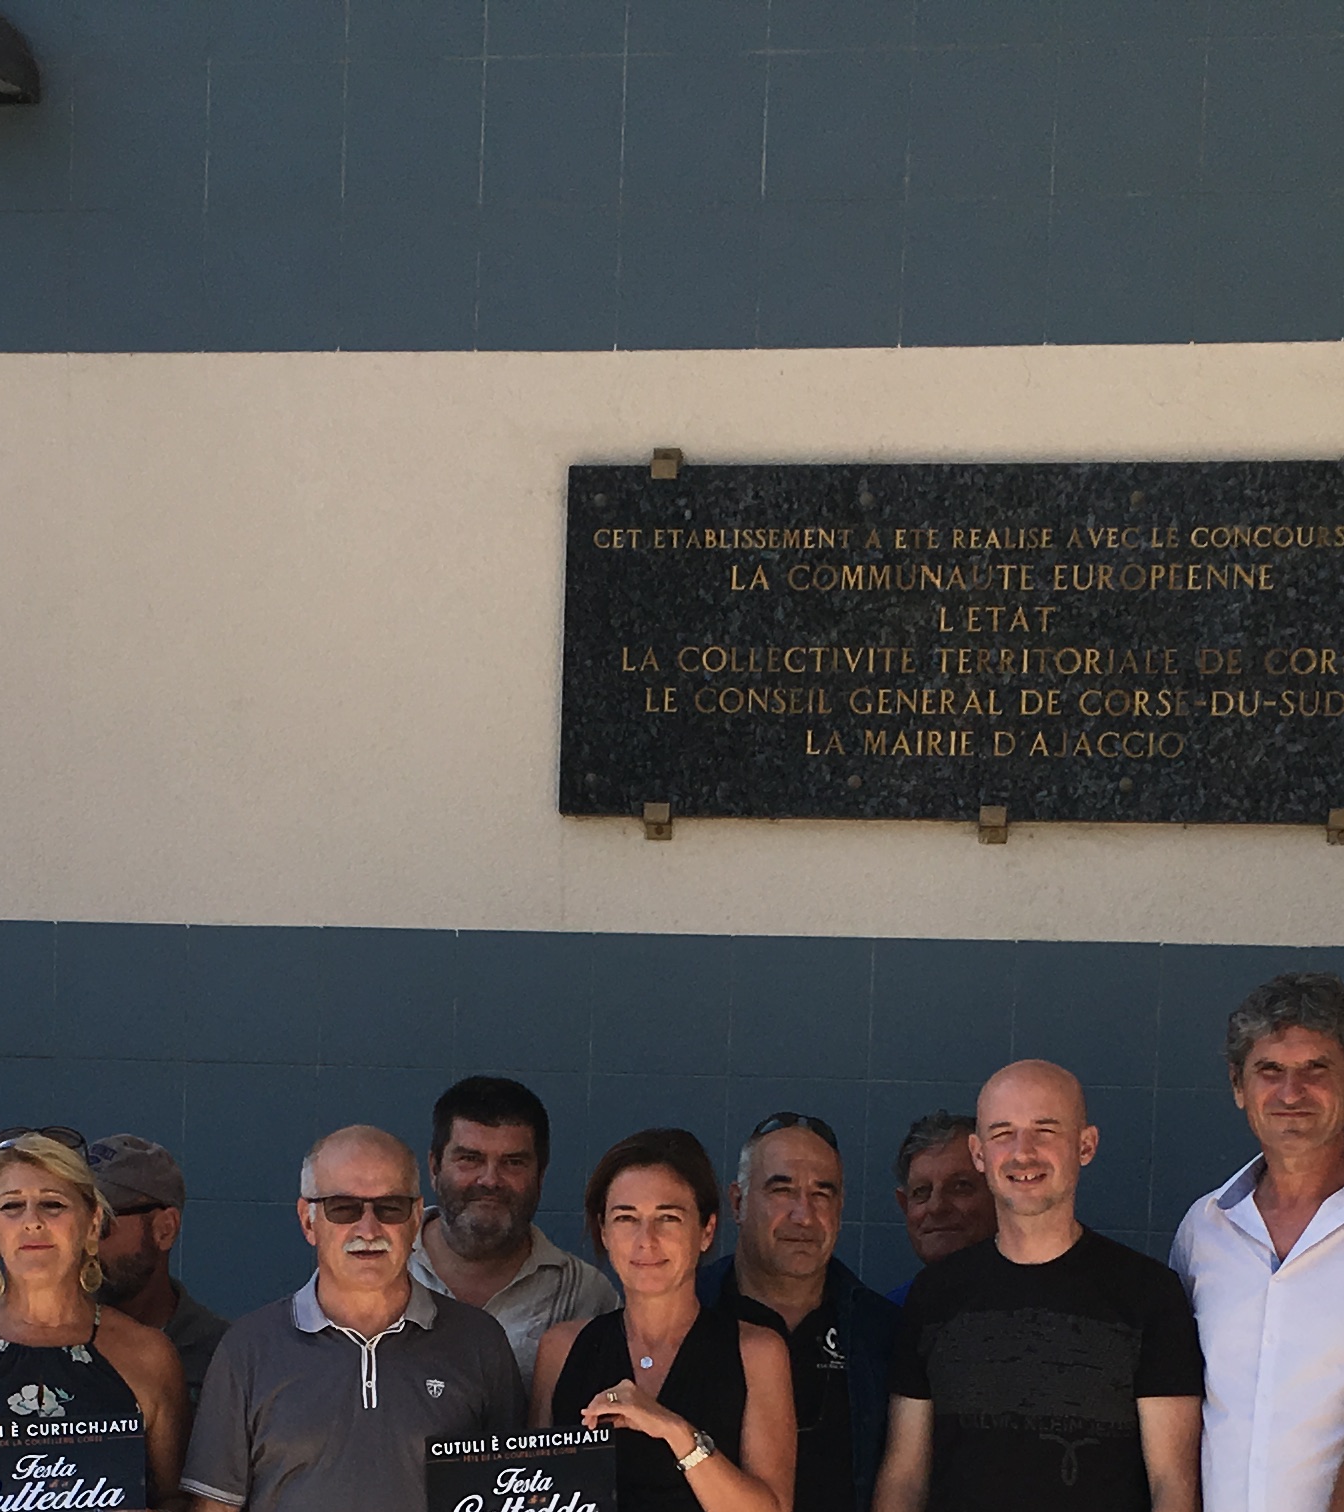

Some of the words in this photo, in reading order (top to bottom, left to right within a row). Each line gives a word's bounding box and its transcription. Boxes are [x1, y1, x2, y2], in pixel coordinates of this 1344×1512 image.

[593, 529, 642, 549] CET
[654, 528, 854, 549] ETABLISSEMENT
[864, 528, 882, 549] A
[895, 528, 940, 549] ETE
[953, 527, 1053, 549] REALISE
[1066, 527, 1140, 549] AVEC
[1151, 527, 1179, 549] LE
[730, 565, 770, 591] LA
[787, 564, 1035, 592] COMMUNAUTE
[1053, 564, 1275, 592] EUROPEENNE
[621, 647, 660, 673] LA
[677, 646, 916, 674] COLLECTIVITE
[935, 647, 1179, 675] TERRITORIALE
[1199, 648, 1243, 675] DE
[644, 687, 678, 713] LE
[694, 687, 833, 714] CONSEIL
[849, 688, 1004, 716] GENERAL
[1020, 689, 1062, 716] DE
[805, 729, 846, 756] LA
[863, 729, 975, 757] MAIRIE
[993, 730, 1184, 758] D'AJACCIO
[11, 1421, 19, 1437] È
[26, 1419, 139, 1438] CURTICHJATU
[432, 1440, 485, 1456] CUTULI
[492, 1435, 499, 1451] È
[506, 1429, 609, 1450] CURTICHJATU
[11, 1453, 77, 1480] Festa
[493, 1467, 554, 1495] Festa
